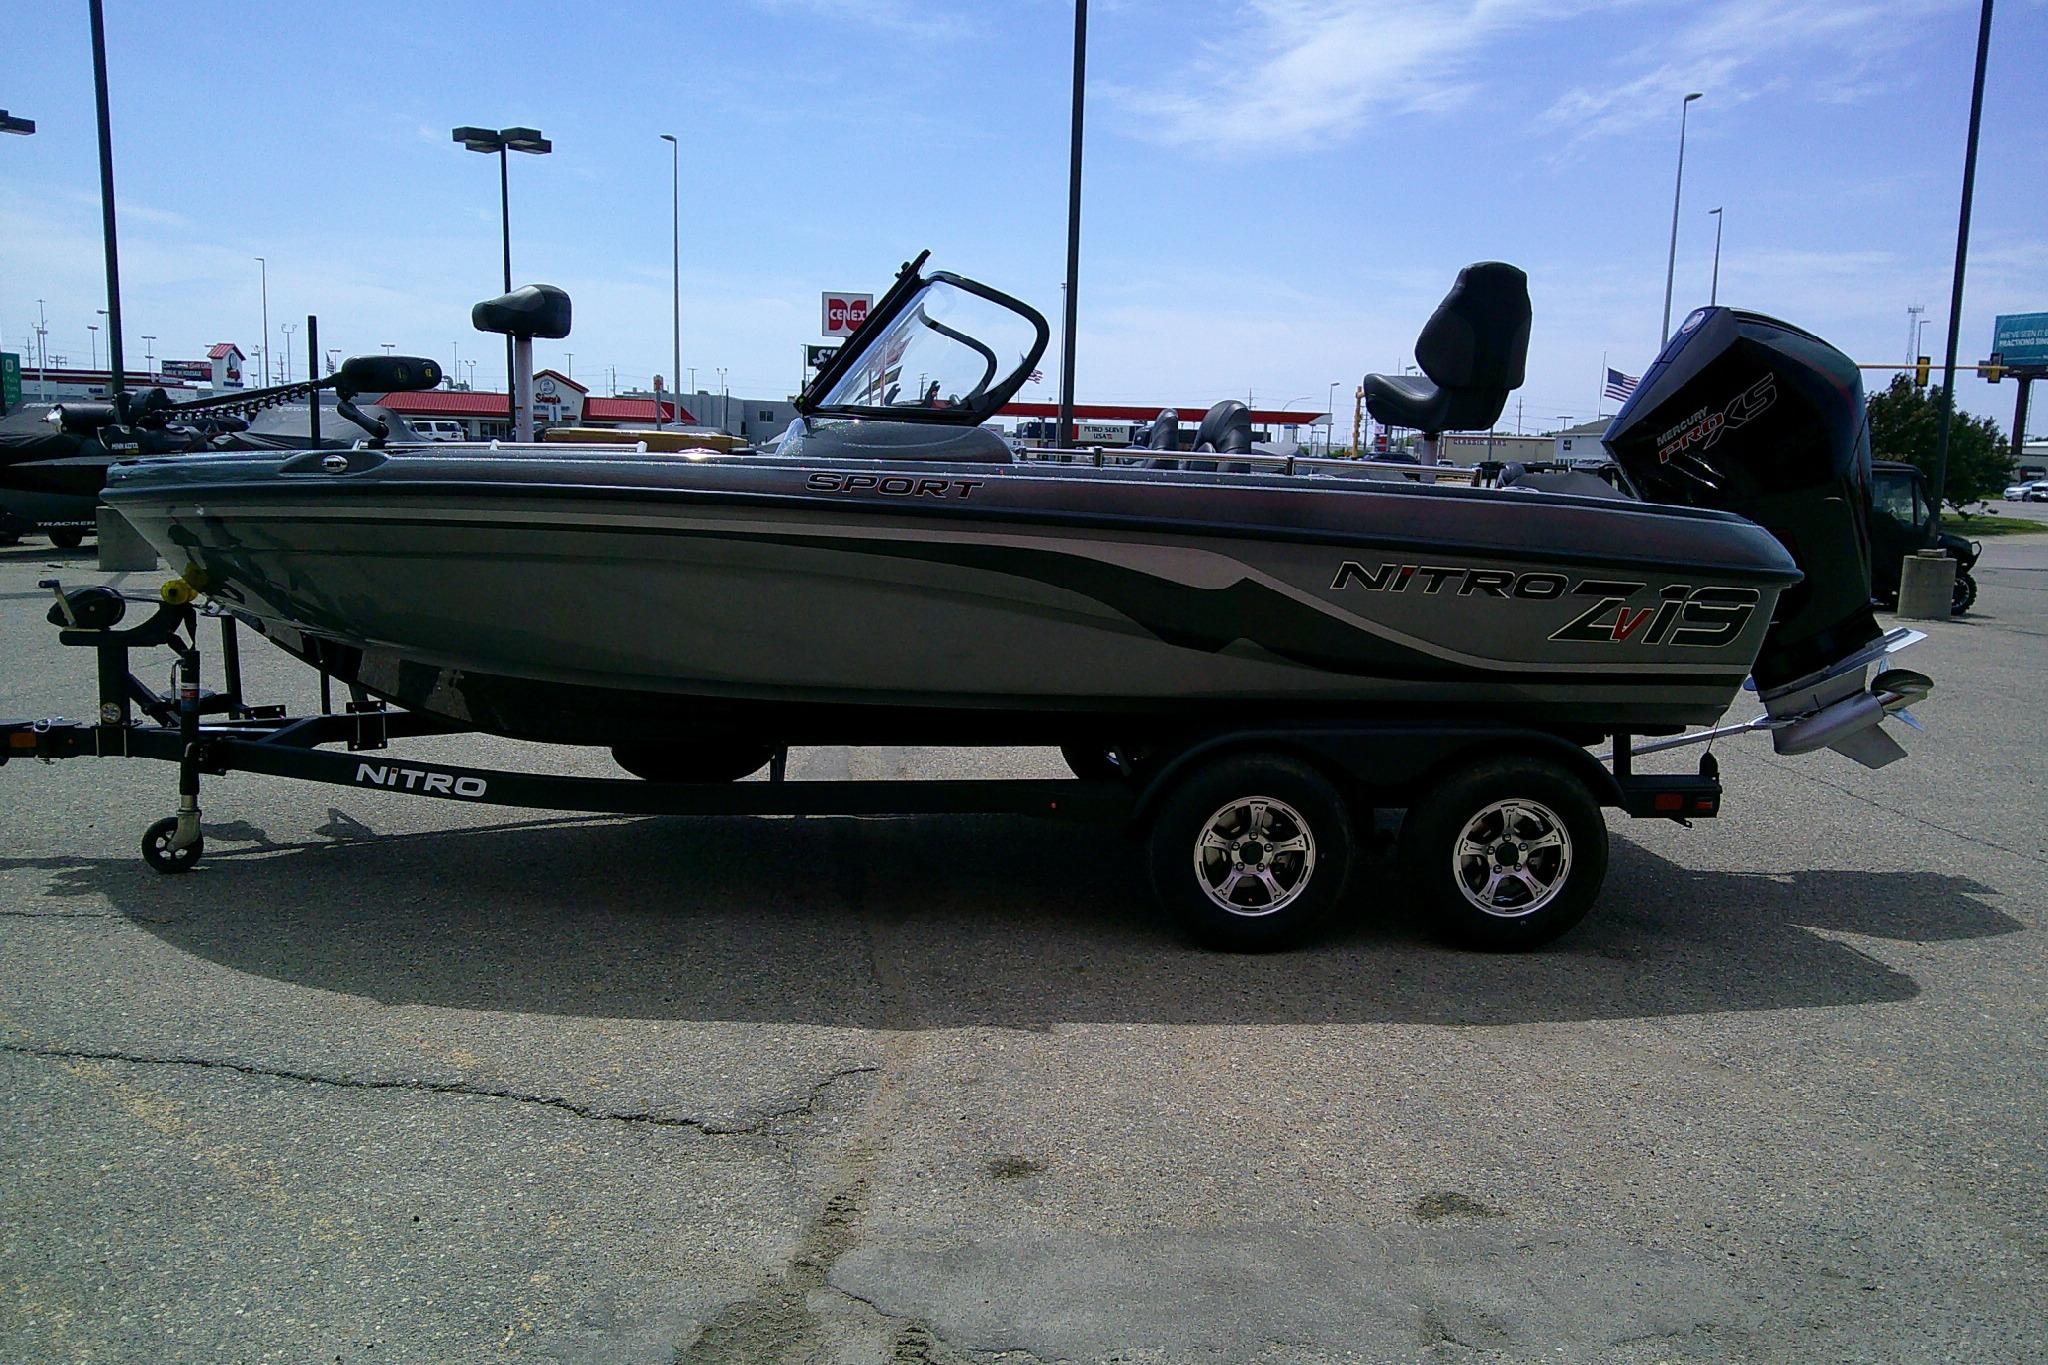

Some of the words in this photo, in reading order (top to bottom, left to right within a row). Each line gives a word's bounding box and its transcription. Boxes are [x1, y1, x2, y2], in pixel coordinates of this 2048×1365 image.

[829, 308, 866, 321] CENEX
[1105, 426, 1124, 434] SERVE
[1656, 406, 1708, 447] MERCURY
[1658, 411, 1725, 465] PRO
[1703, 371, 1777, 450] XS
[111, 442, 124, 450] MINN
[805, 473, 985, 500] SPORT
[1329, 561, 1570, 599] NITRO
[355, 763, 487, 798] NITRO
